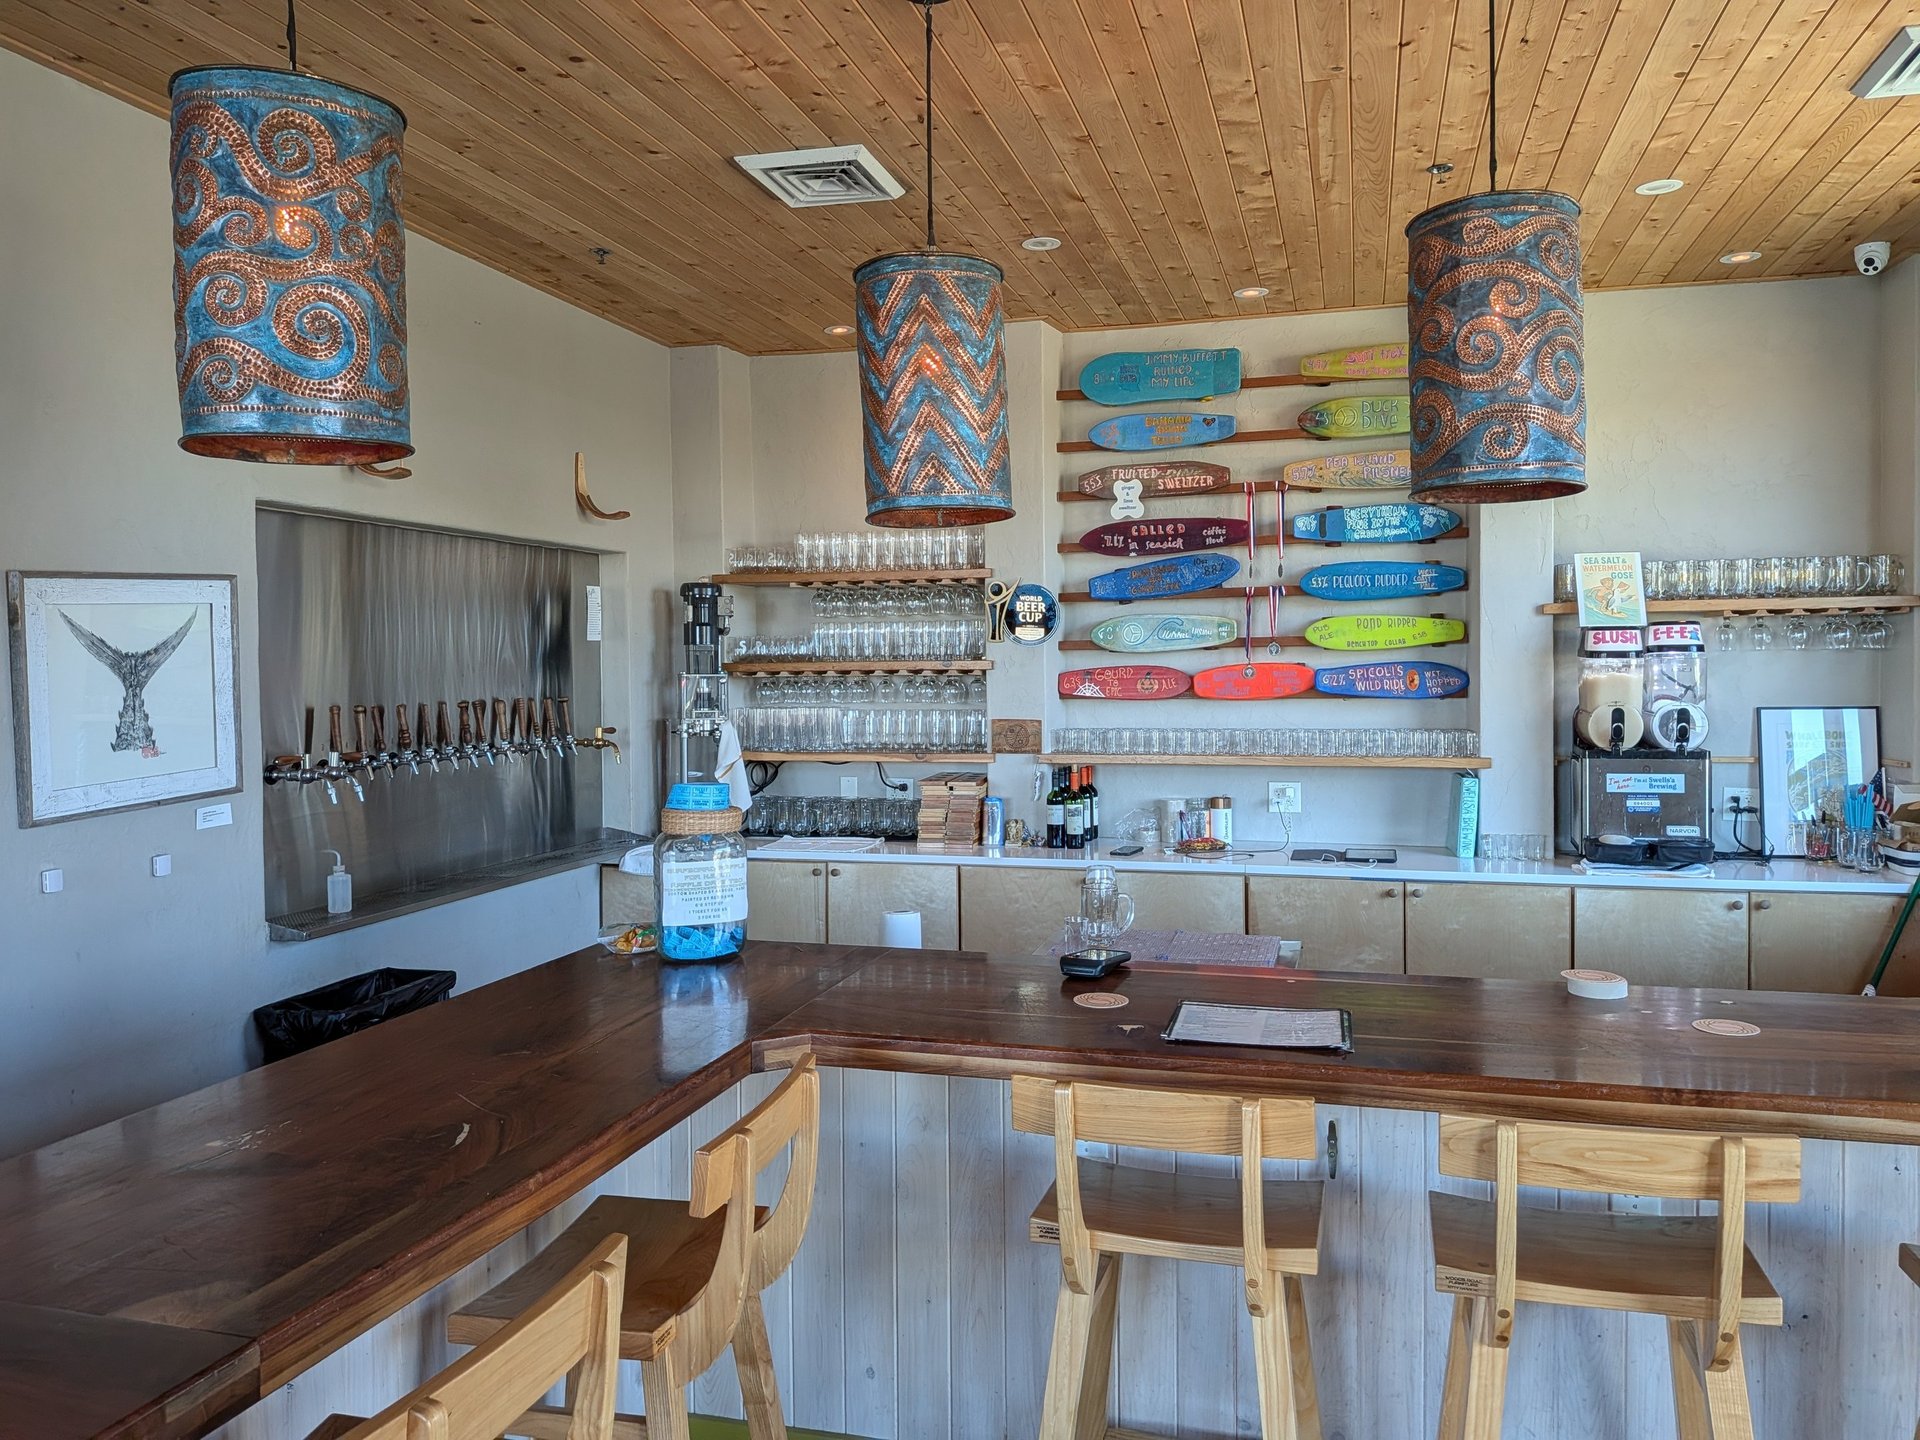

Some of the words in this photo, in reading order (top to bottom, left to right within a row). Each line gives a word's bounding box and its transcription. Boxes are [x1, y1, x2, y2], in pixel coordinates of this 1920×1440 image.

[1361, 400, 1399, 413] DUCK
[1326, 456, 1348, 469] PEA
[1354, 453, 1395, 466] ISLAND
[1112, 467, 1159, 480] FRUITED
[1158, 475, 1213, 490] SWELTZER
[1583, 557, 1600, 565] SEA
[1601, 556, 1620, 564] SALT
[1582, 564, 1633, 572] WATERMELON
[1375, 573, 1409, 587] RUDDER
[1611, 571, 1633, 579] GOSE
[1016, 601, 1046, 612] BEER
[1018, 612, 1042, 622] CUP
[1312, 623, 1330, 634] PUB
[1319, 631, 1334, 642] ALE
[1592, 630, 1638, 645] SLUSH
[1348, 664, 1404, 679] SPICOLI'S
[1161, 677, 1177, 691] ALE
[1355, 680, 1381, 691] WILD
[1383, 679, 1405, 690] RIDE
[1426, 678, 1461, 687] HOPPED
[1106, 686, 1122, 697] EPIC
[1428, 687, 1444, 696] IPA
